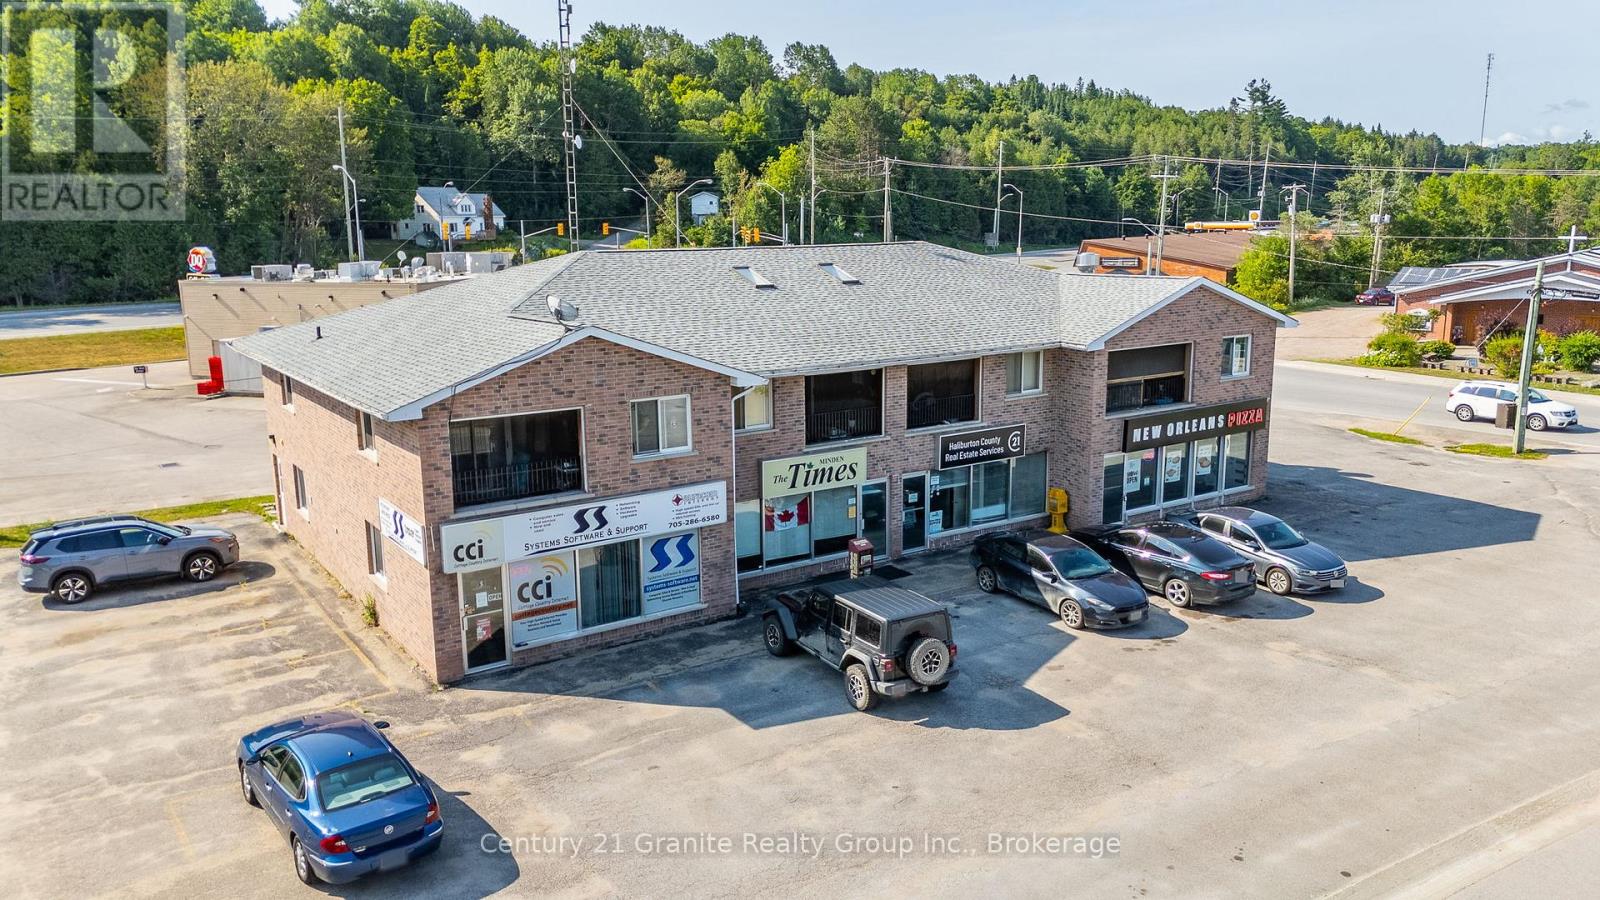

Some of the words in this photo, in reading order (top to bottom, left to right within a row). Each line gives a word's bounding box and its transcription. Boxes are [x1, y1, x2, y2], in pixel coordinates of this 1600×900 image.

[1132, 424, 1162, 443] NEW
[1166, 414, 1225, 437] ORLEANS
[1227, 407, 1265, 428] PIZZA
[948, 439, 980, 452] Haliburton
[980, 435, 1001, 447] County
[819, 455, 844, 465] MINDEN
[945, 451, 959, 463] Real
[959, 448, 979, 460] Estate
[979, 445, 1004, 457] Services
[773, 474, 788, 484] The
[787, 462, 858, 490] Times
[668, 514, 720, 529] 705-286-6580
[607, 527, 613, 537] &
